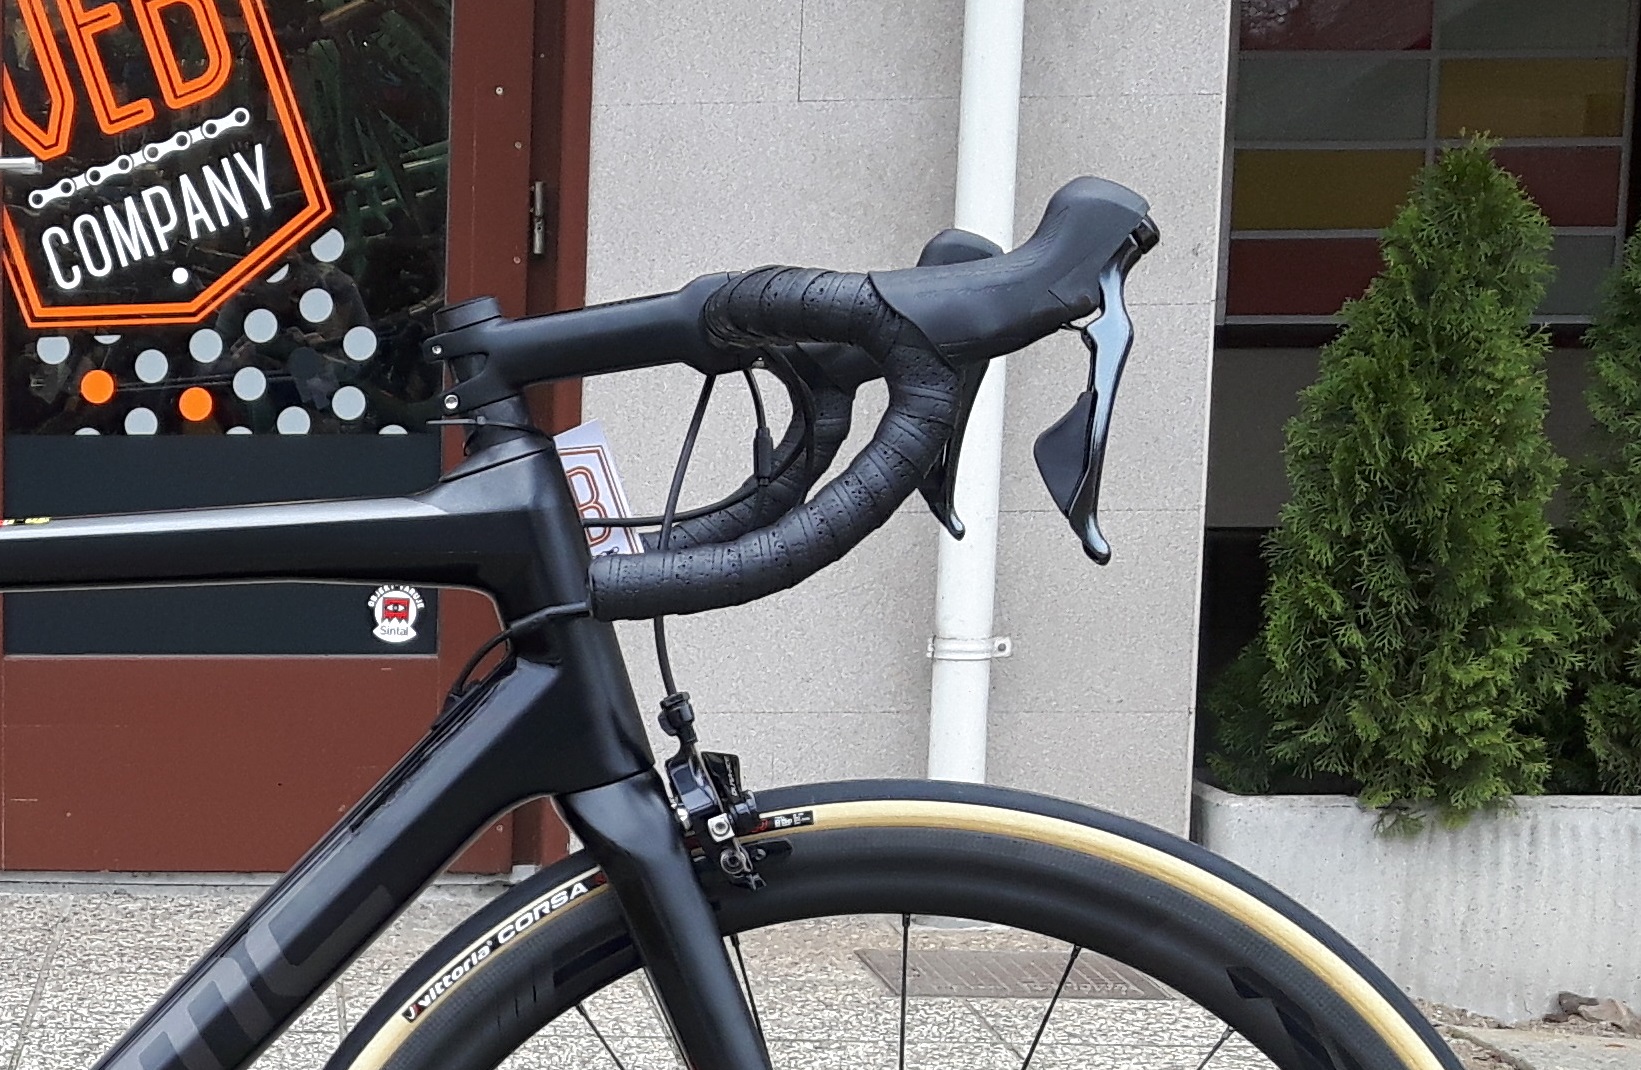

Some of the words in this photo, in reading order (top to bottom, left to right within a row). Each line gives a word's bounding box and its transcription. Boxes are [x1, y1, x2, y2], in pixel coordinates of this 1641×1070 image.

[42, 143, 272, 290] COMPANY
[379, 625, 409, 636] Sintal
[497, 881, 590, 945] CORSA
